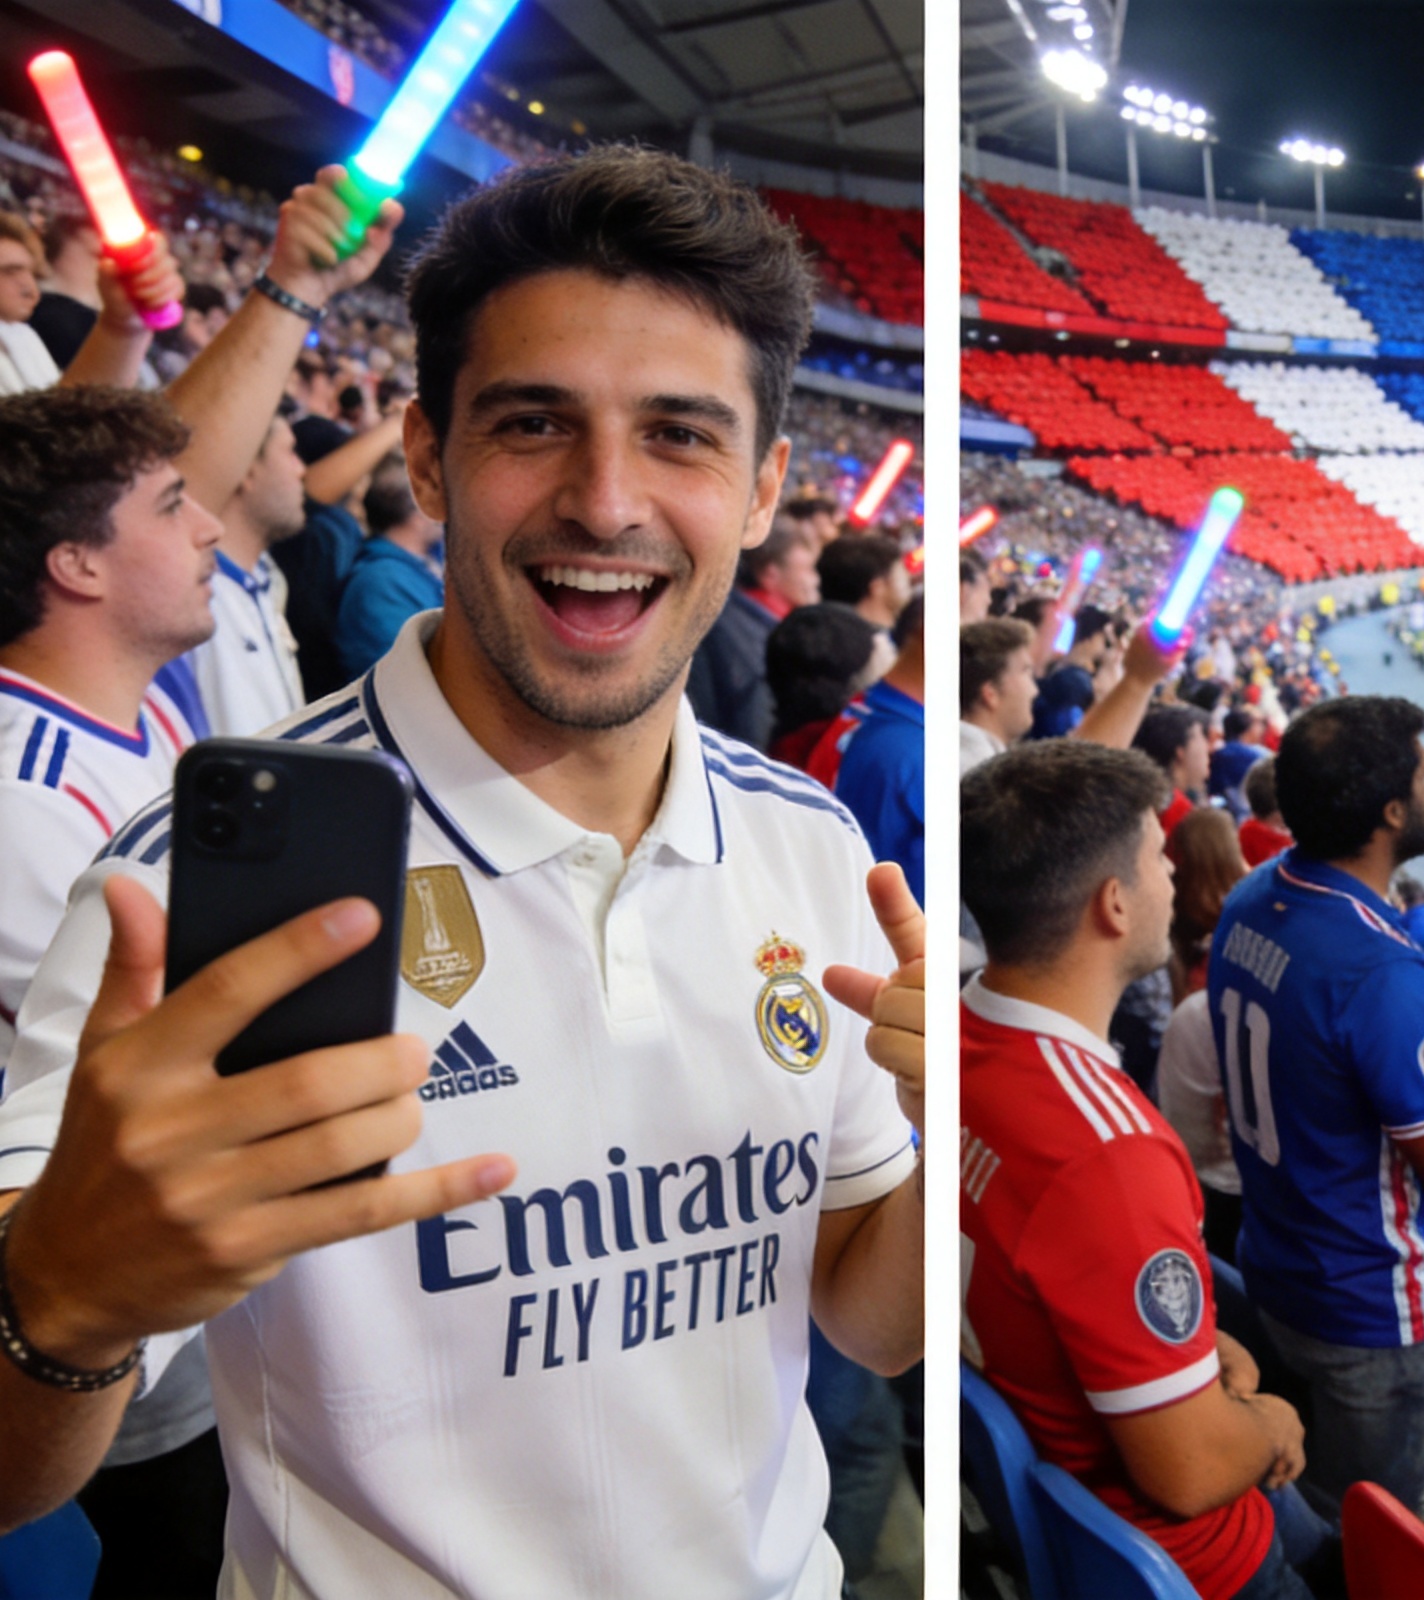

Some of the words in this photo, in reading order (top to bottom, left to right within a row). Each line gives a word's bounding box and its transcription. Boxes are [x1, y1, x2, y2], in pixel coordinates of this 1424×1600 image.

[416, 1128, 819, 1293] Emirates
[503, 1278, 600, 1377] FLY
[621, 1233, 781, 1351] BETTER
